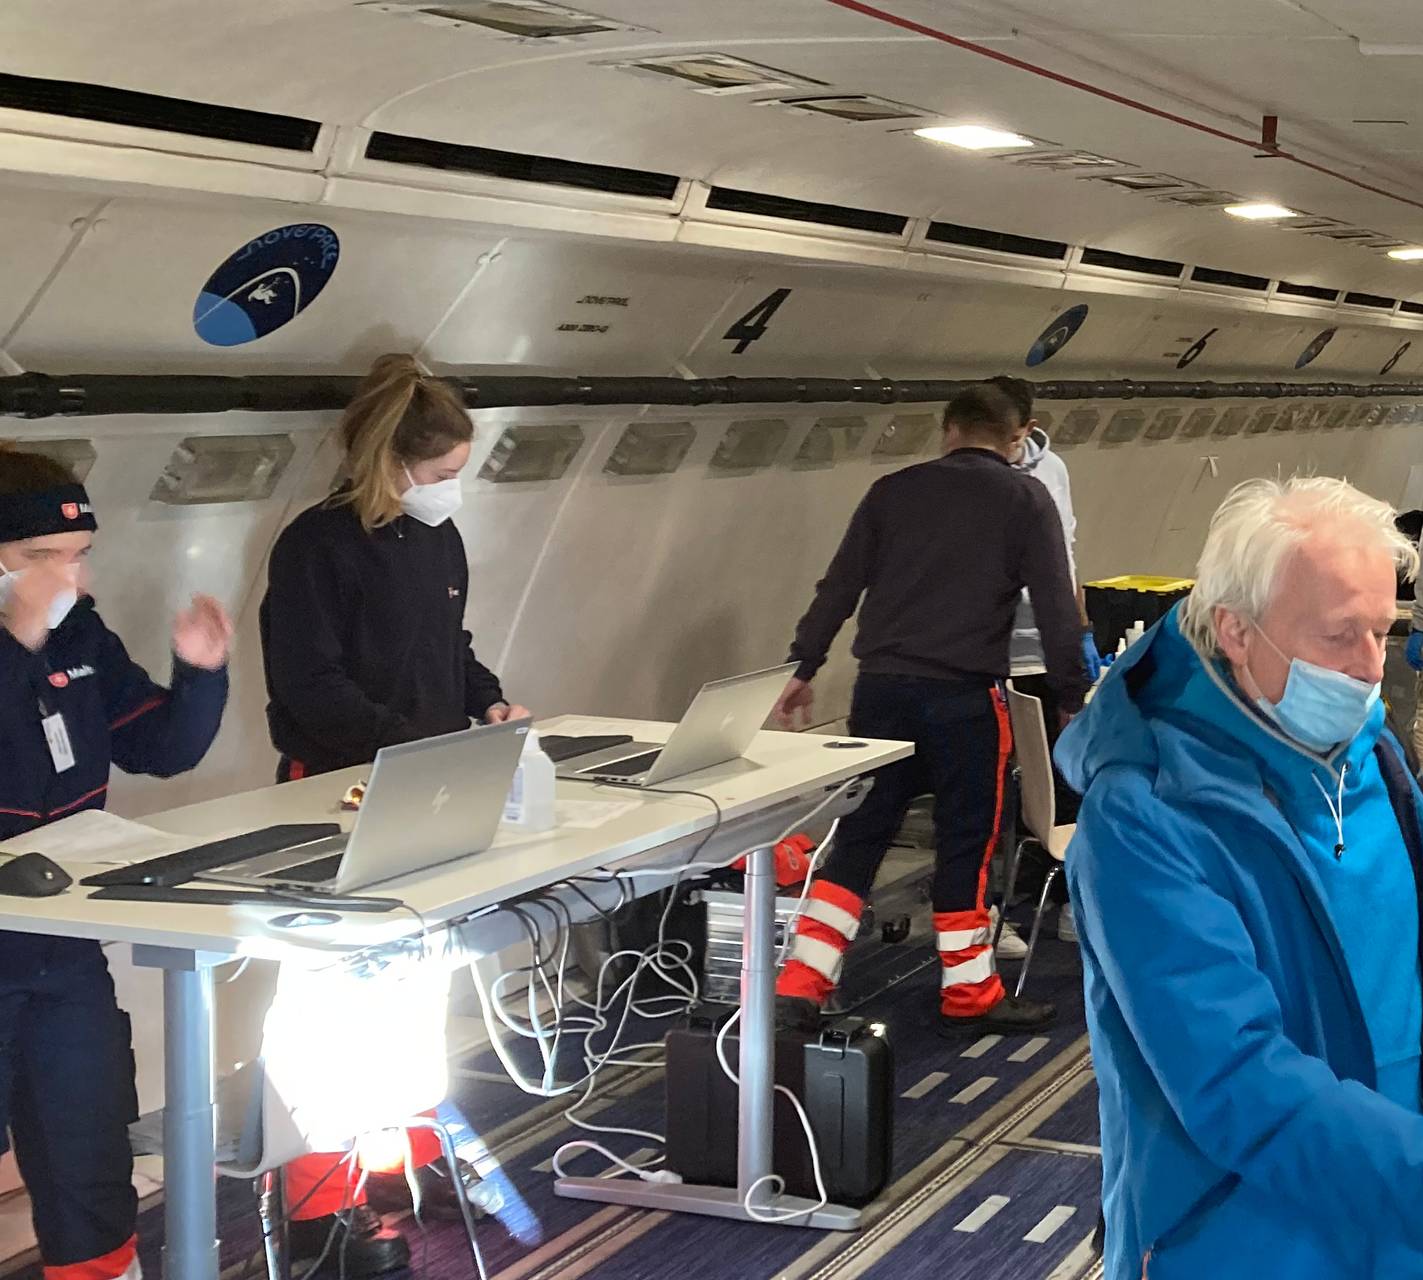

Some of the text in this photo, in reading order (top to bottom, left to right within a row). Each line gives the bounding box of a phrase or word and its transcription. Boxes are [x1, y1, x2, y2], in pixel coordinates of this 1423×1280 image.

[722, 288, 792, 353] 4
[1176, 328, 1219, 369] 6
[1380, 341, 1412, 375] 8
